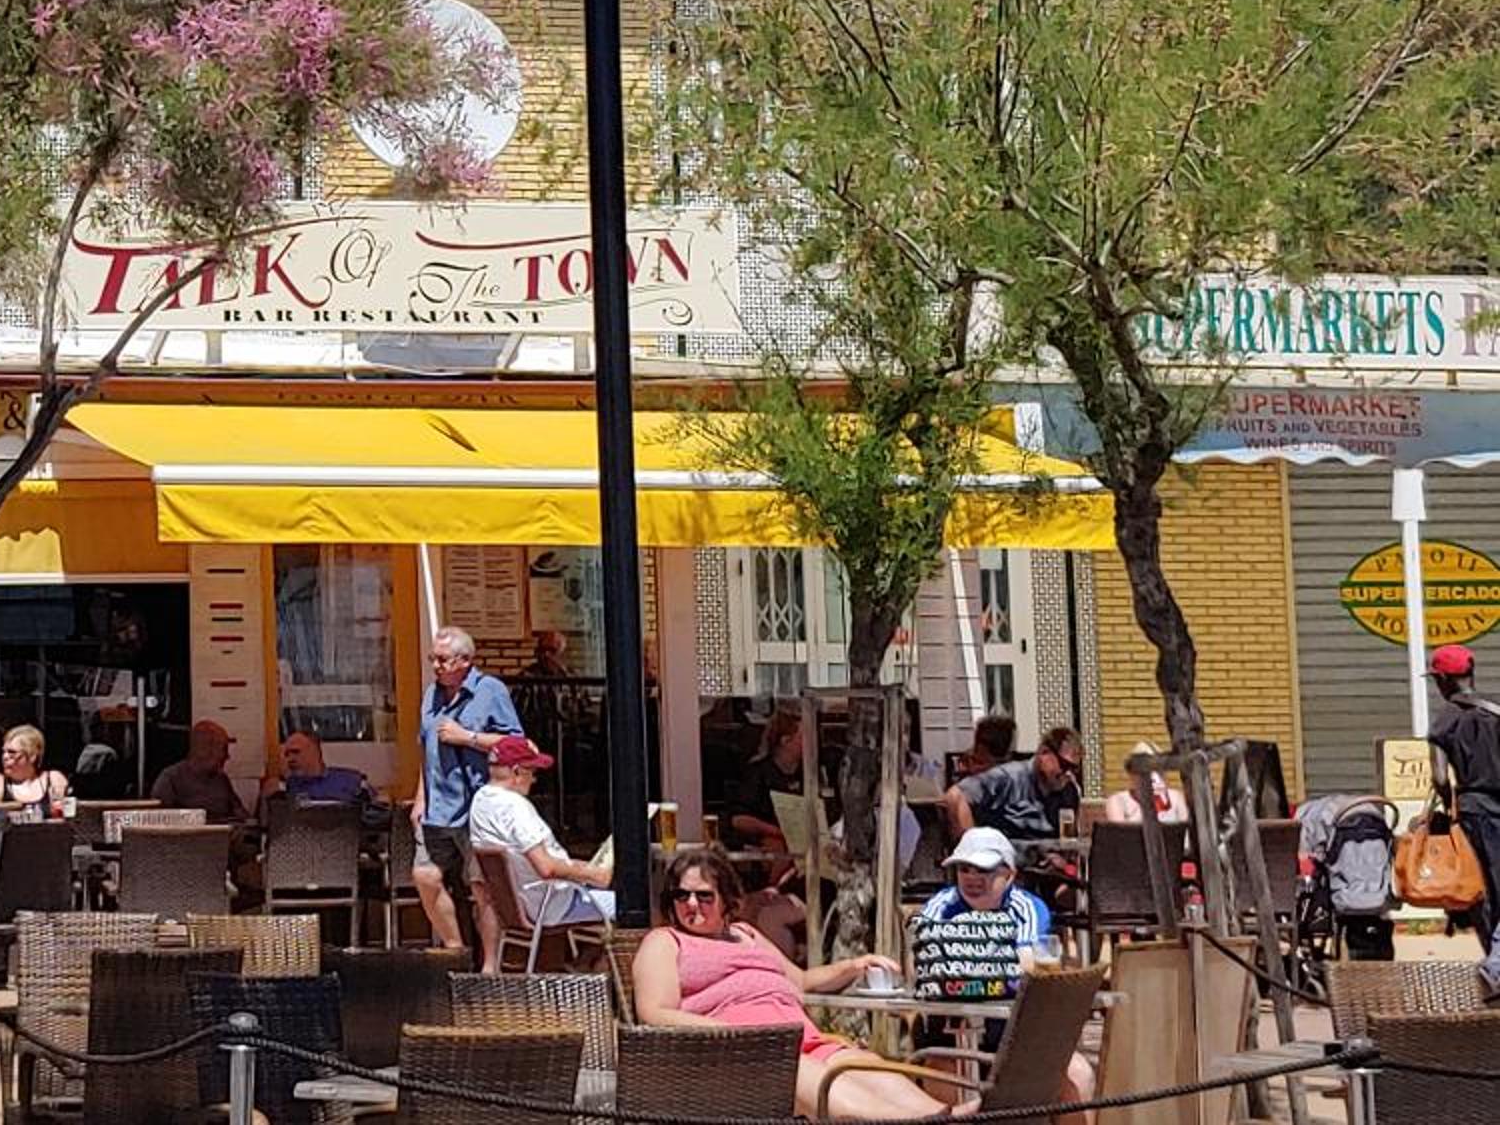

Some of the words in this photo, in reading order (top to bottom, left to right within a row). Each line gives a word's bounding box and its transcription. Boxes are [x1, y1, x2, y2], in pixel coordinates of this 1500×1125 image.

[73, 215, 334, 316] TALK
[407, 261, 501, 322] The
[223, 308, 294, 323] BAR
[313, 308, 546, 325] RESTAURANT
[1314, 419, 1423, 438] VEGETABLES
[1373, 610, 1458, 637] RODA
